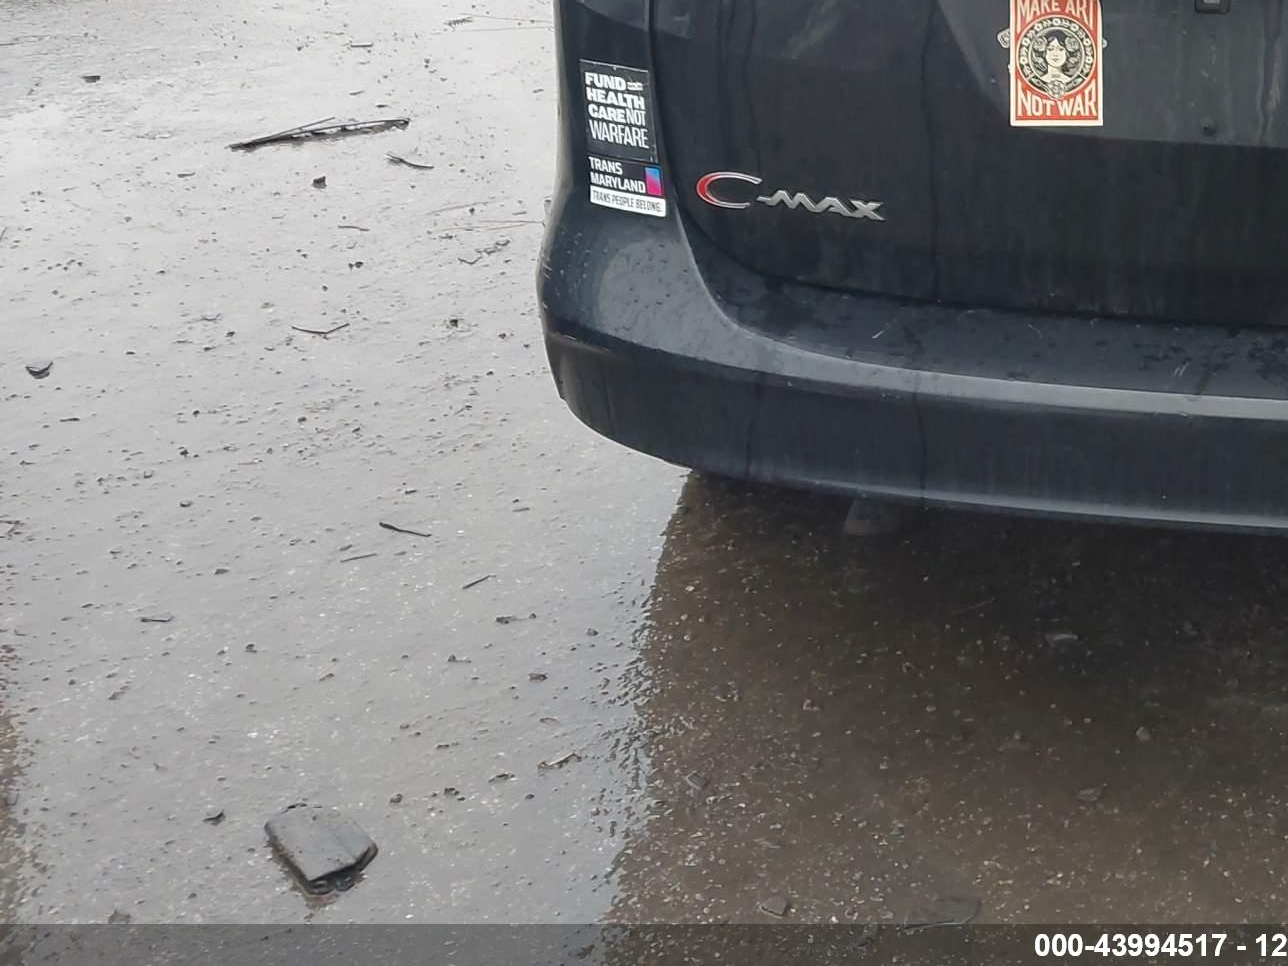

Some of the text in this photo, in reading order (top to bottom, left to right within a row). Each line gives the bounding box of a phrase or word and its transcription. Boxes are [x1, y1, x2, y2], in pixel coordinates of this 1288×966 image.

[585, 72, 626, 90] FUND
[586, 87, 645, 109] HEALTH
[1017, 79, 1097, 116] NOT WAR
[588, 104, 646, 126] CARE NOT
[589, 119, 649, 148] WARFARE
[588, 156, 623, 175] TRANS
[590, 172, 646, 193] MARYLAND
[593, 190, 610, 203] TRANS
[612, 195, 634, 207] PEOPLE
